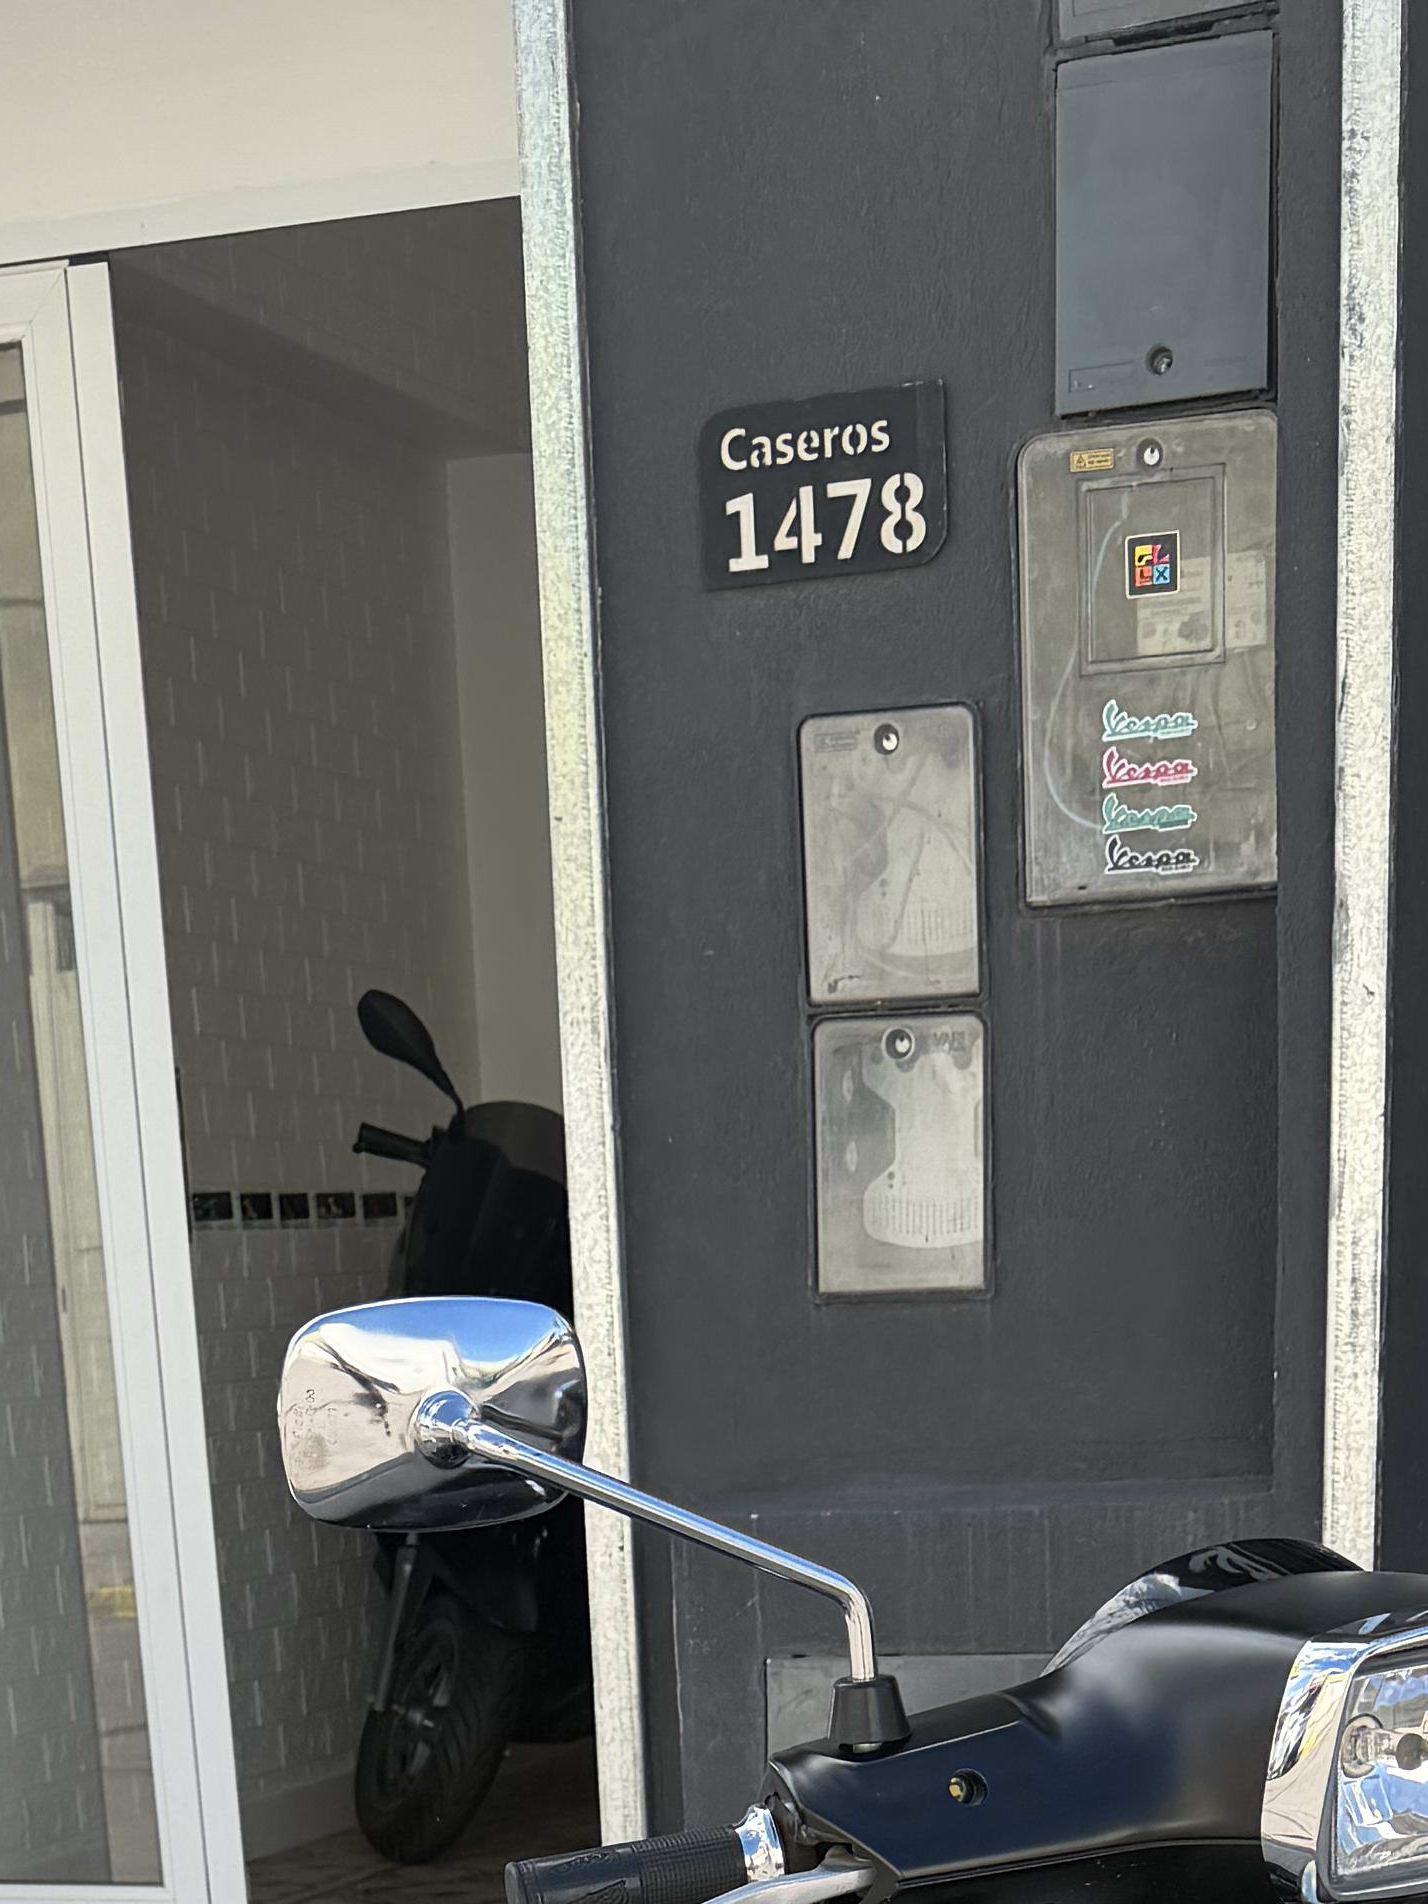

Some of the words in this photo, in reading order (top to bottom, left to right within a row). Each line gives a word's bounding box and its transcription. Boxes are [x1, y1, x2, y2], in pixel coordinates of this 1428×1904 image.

[721, 419, 891, 472] Caseros
[726, 472, 927, 574] 1478
[1105, 701, 1196, 738] Vespa
[1105, 749, 1196, 785] Vespa
[1105, 795, 1196, 832] Vespa
[1107, 836, 1197, 872] Vespa
